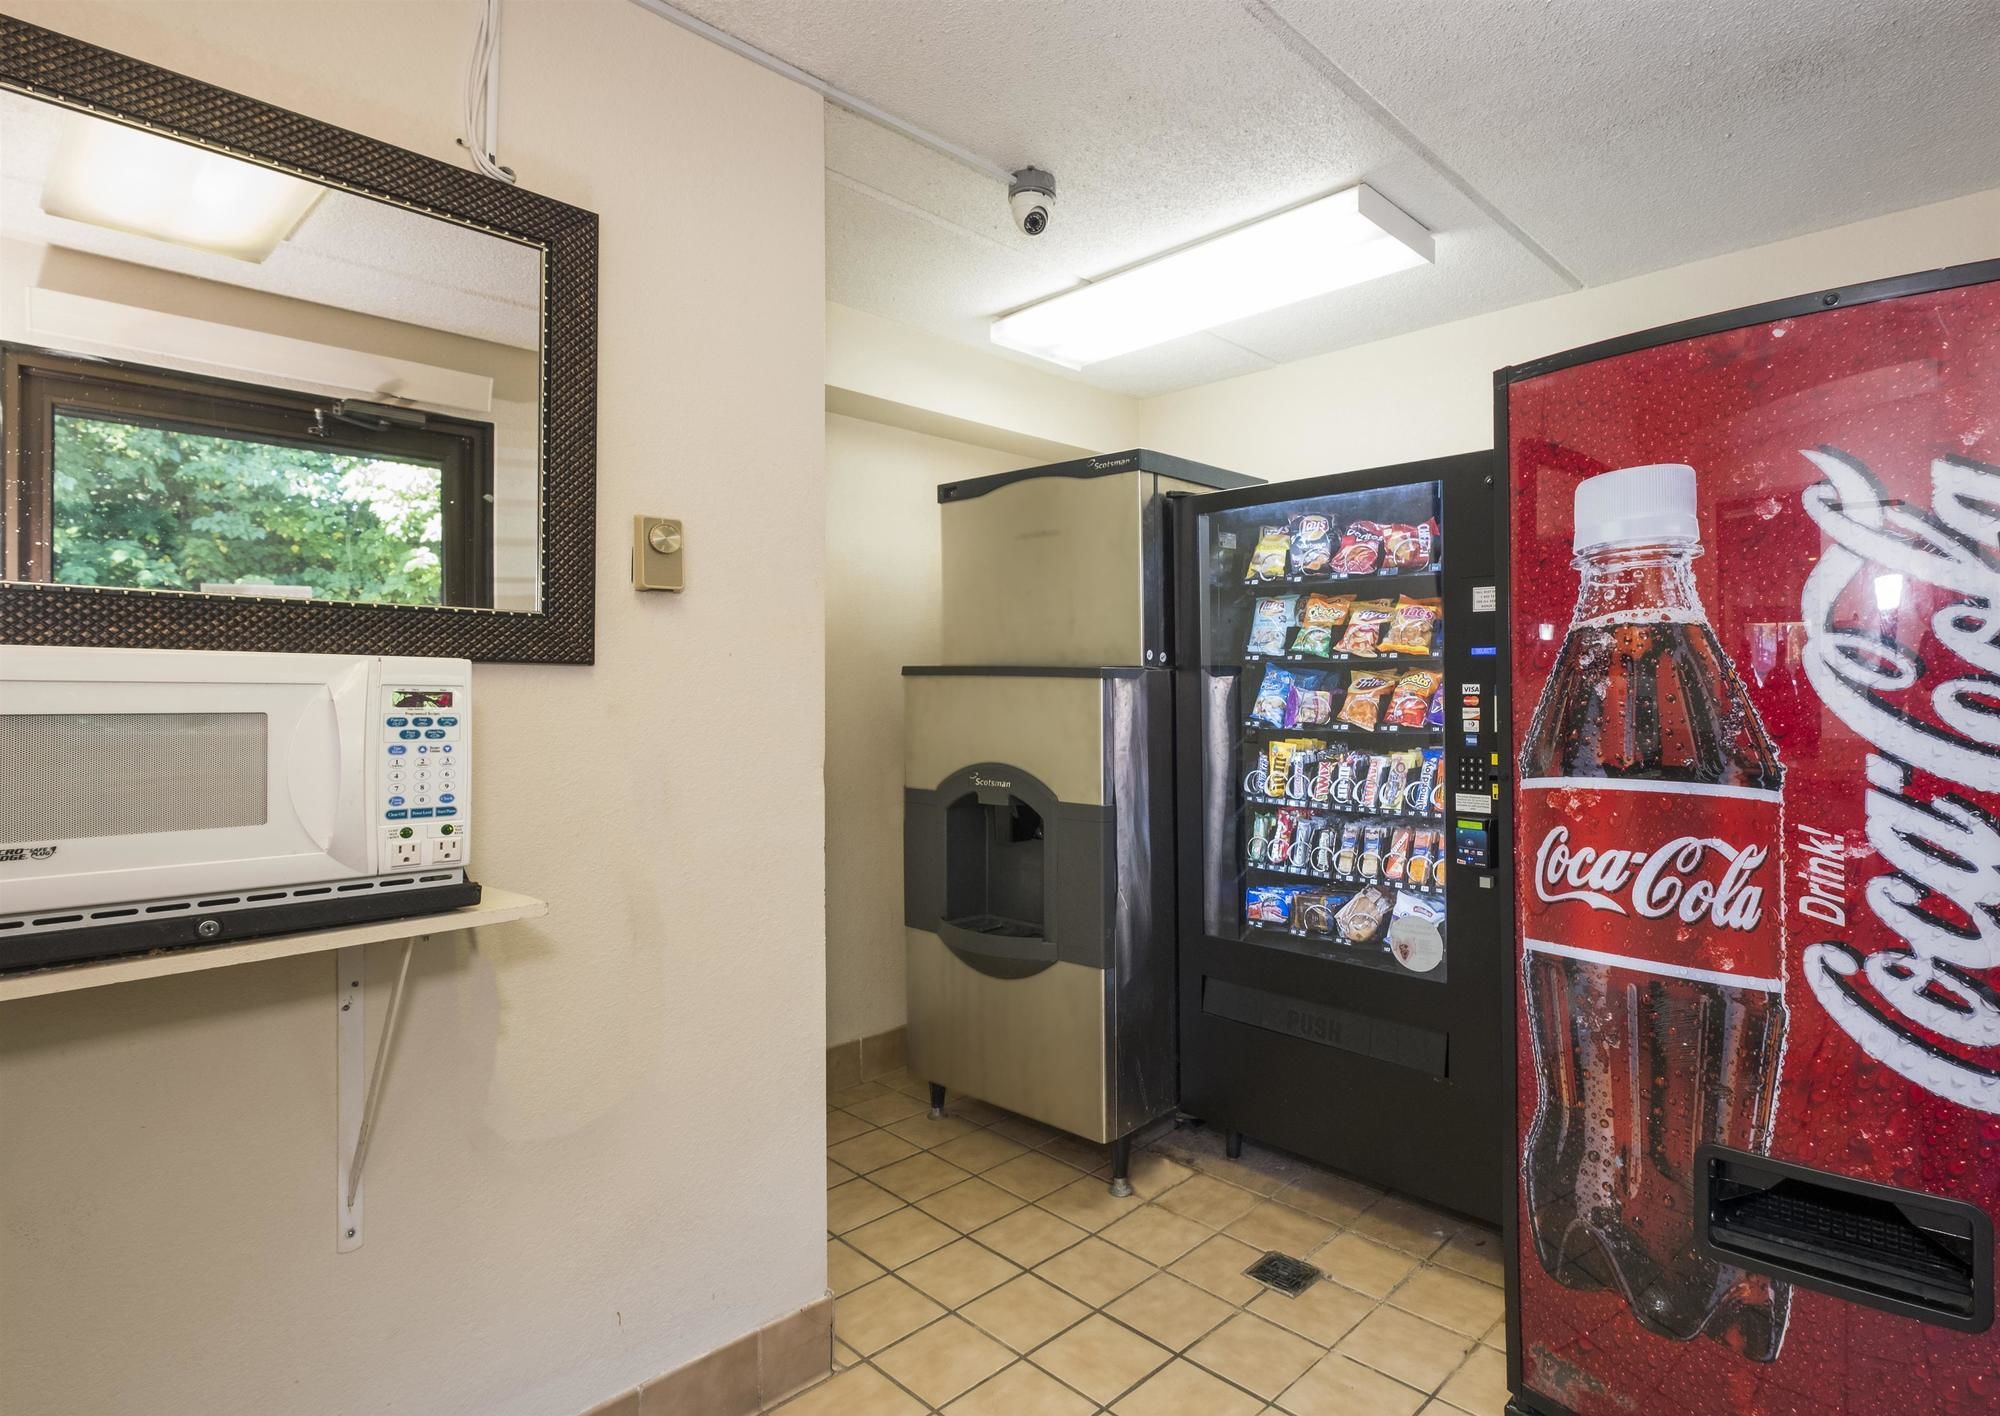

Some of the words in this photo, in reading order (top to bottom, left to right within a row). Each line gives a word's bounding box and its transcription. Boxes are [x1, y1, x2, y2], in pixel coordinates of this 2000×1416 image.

[1094, 458, 1131, 469] Scotsman
[1463, 685, 1480, 693] VISA
[975, 777, 1011, 788] Scotsman
[1535, 825, 1768, 932] Coca-Cola
[1798, 824, 1846, 927] Drink!
[1287, 1009, 1343, 1043] PUSH
